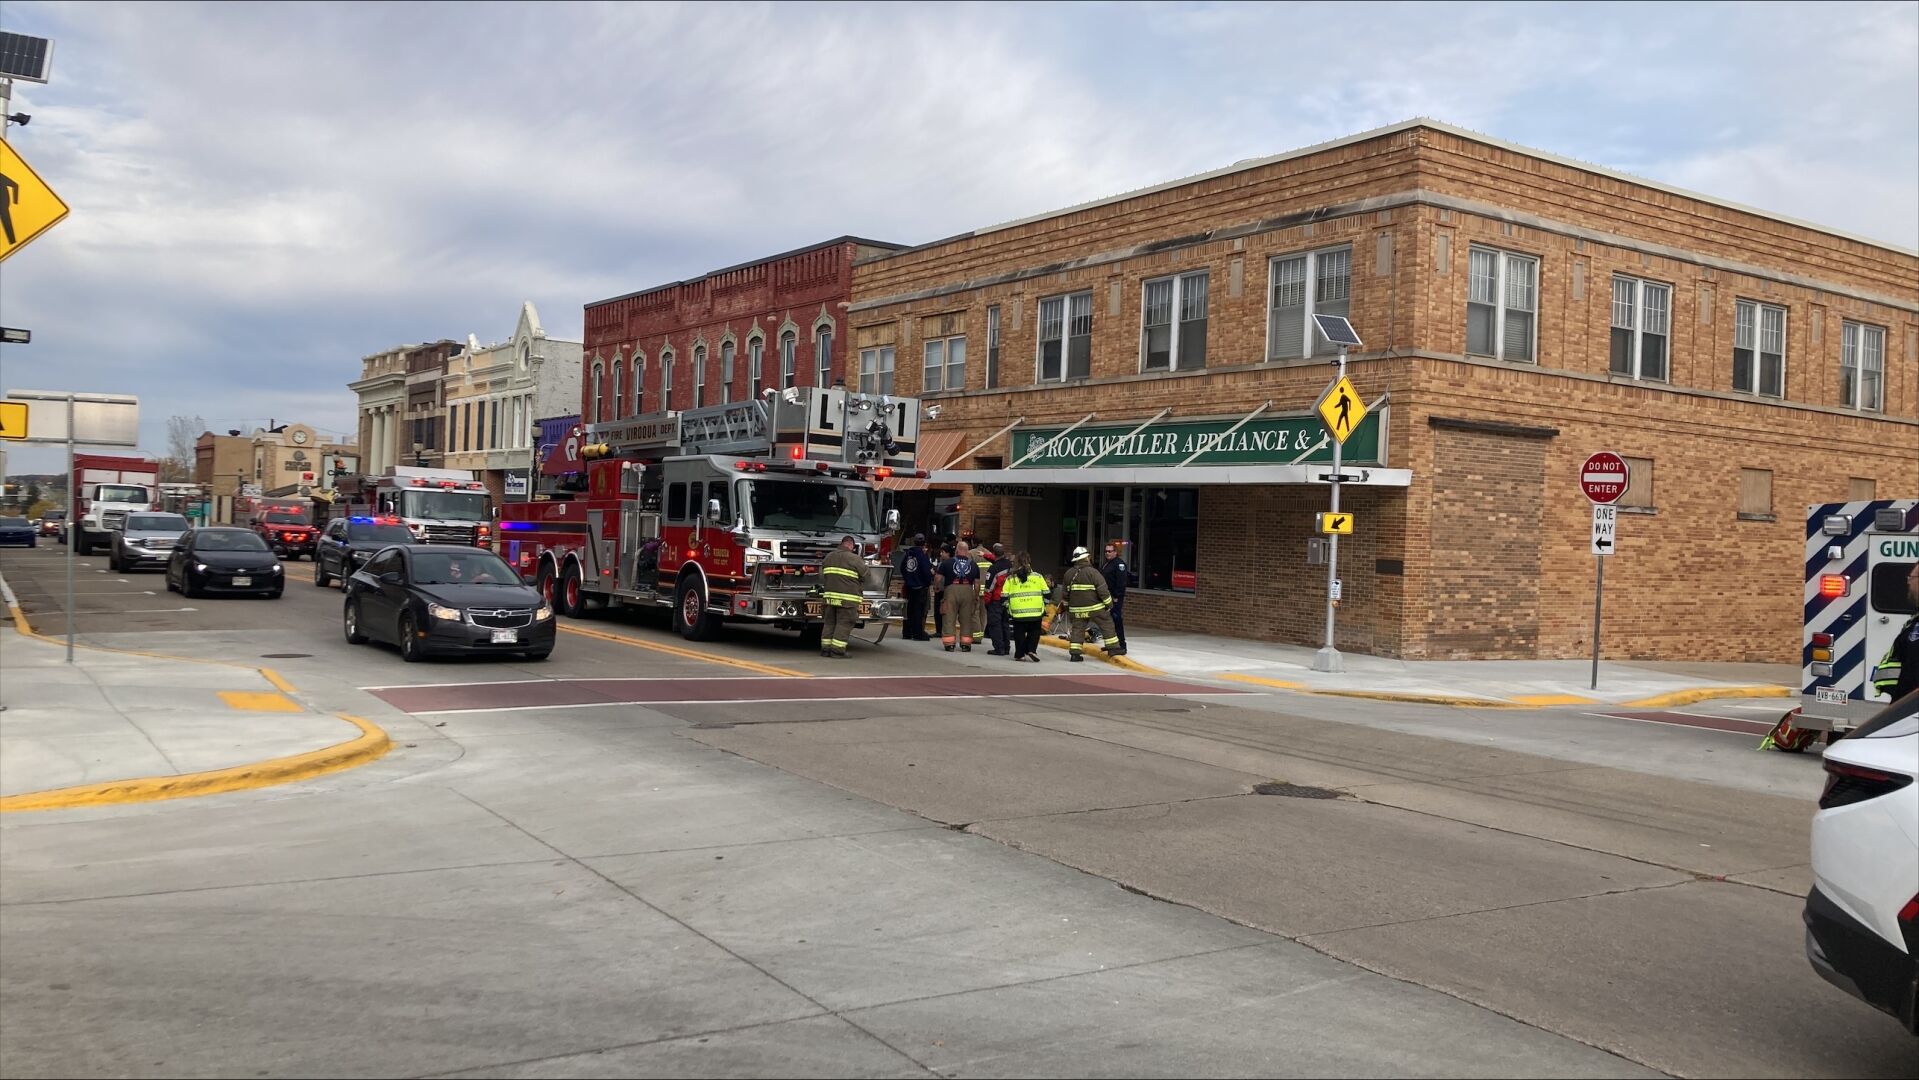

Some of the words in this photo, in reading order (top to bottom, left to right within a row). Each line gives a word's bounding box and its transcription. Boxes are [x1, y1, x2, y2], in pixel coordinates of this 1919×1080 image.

[820, 394, 834, 430] L
[897, 402, 906, 437] 1
[611, 430, 623, 440] FIRE
[626, 424, 657, 440] VIROQUA
[1046, 432, 1178, 458] ROCKWEILER
[1182, 430, 1290, 453] APPLIANCE
[1294, 429, 1311, 450] &
[1588, 462, 1601, 471] DO
[1602, 462, 1620, 471] NOT
[977, 484, 1044, 497] ROCKWEILER
[1588, 484, 1618, 493] ENTER
[1596, 508, 1614, 520] ONE
[1595, 523, 1613, 535] WAY
